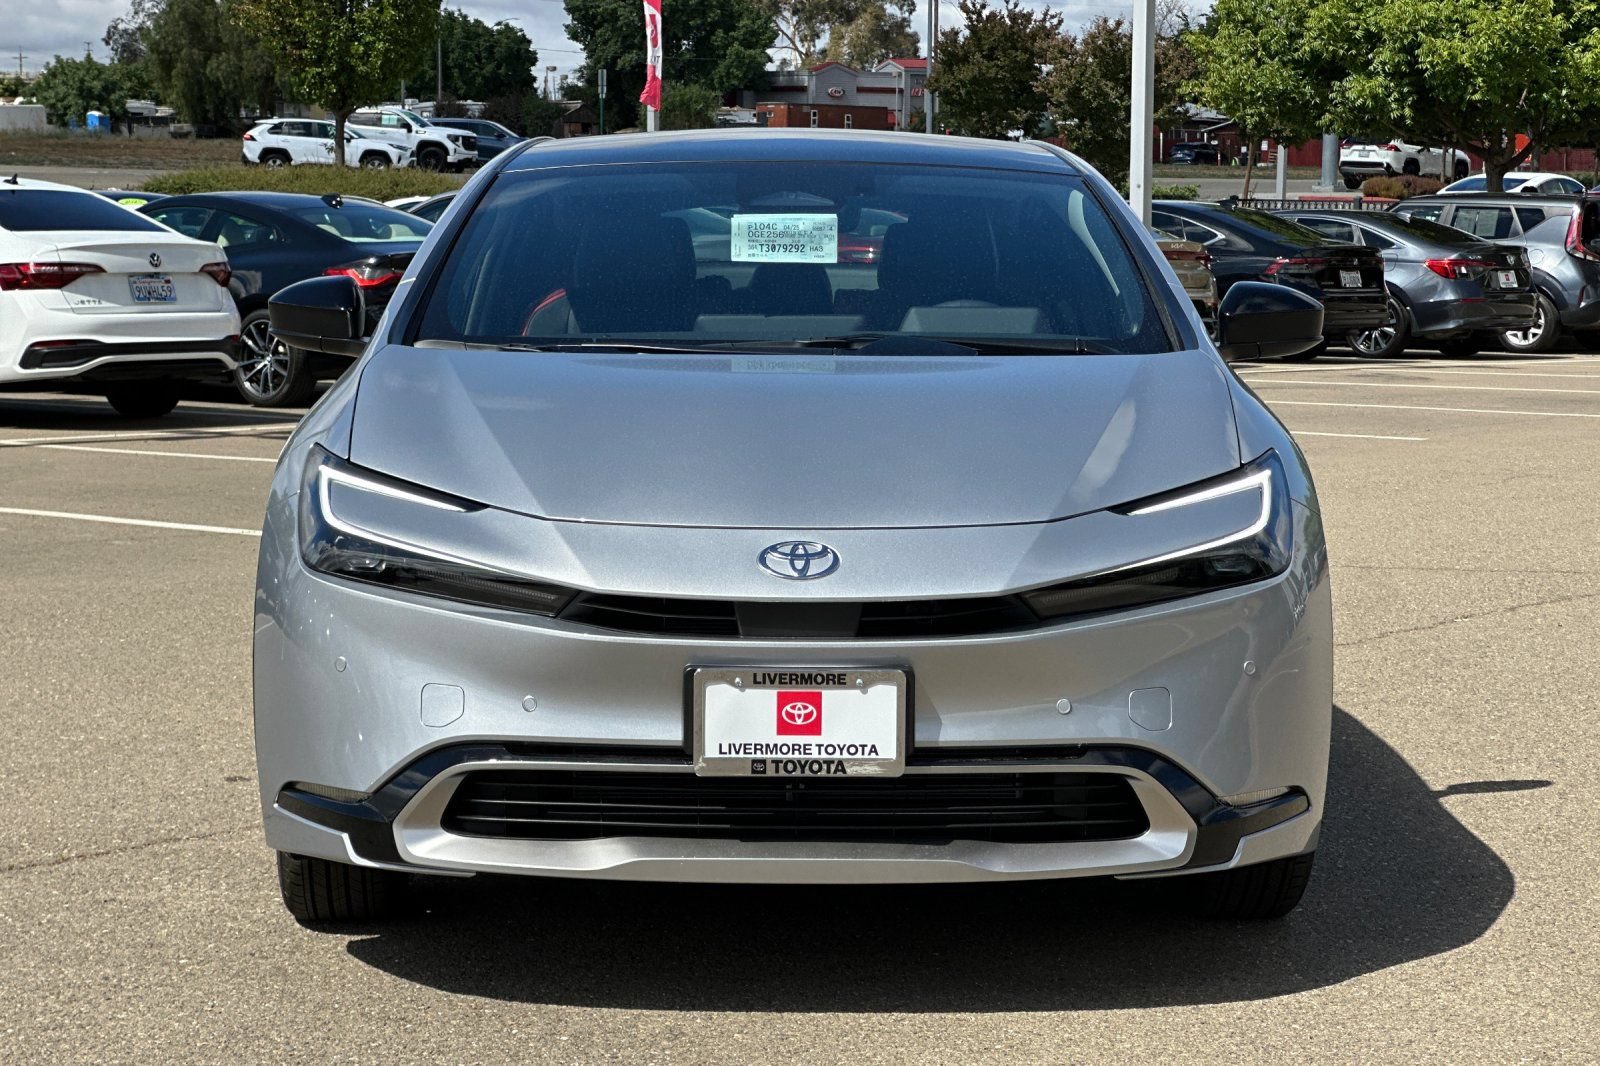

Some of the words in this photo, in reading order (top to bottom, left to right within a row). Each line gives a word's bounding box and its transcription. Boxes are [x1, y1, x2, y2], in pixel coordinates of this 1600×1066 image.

[759, 243, 806, 253] T3079292
[752, 672, 847, 686] LIVERMORE
[718, 743, 813, 756] LIVERMORE
[815, 743, 879, 756] TOYOTA
[771, 760, 847, 775] TOYOTA
